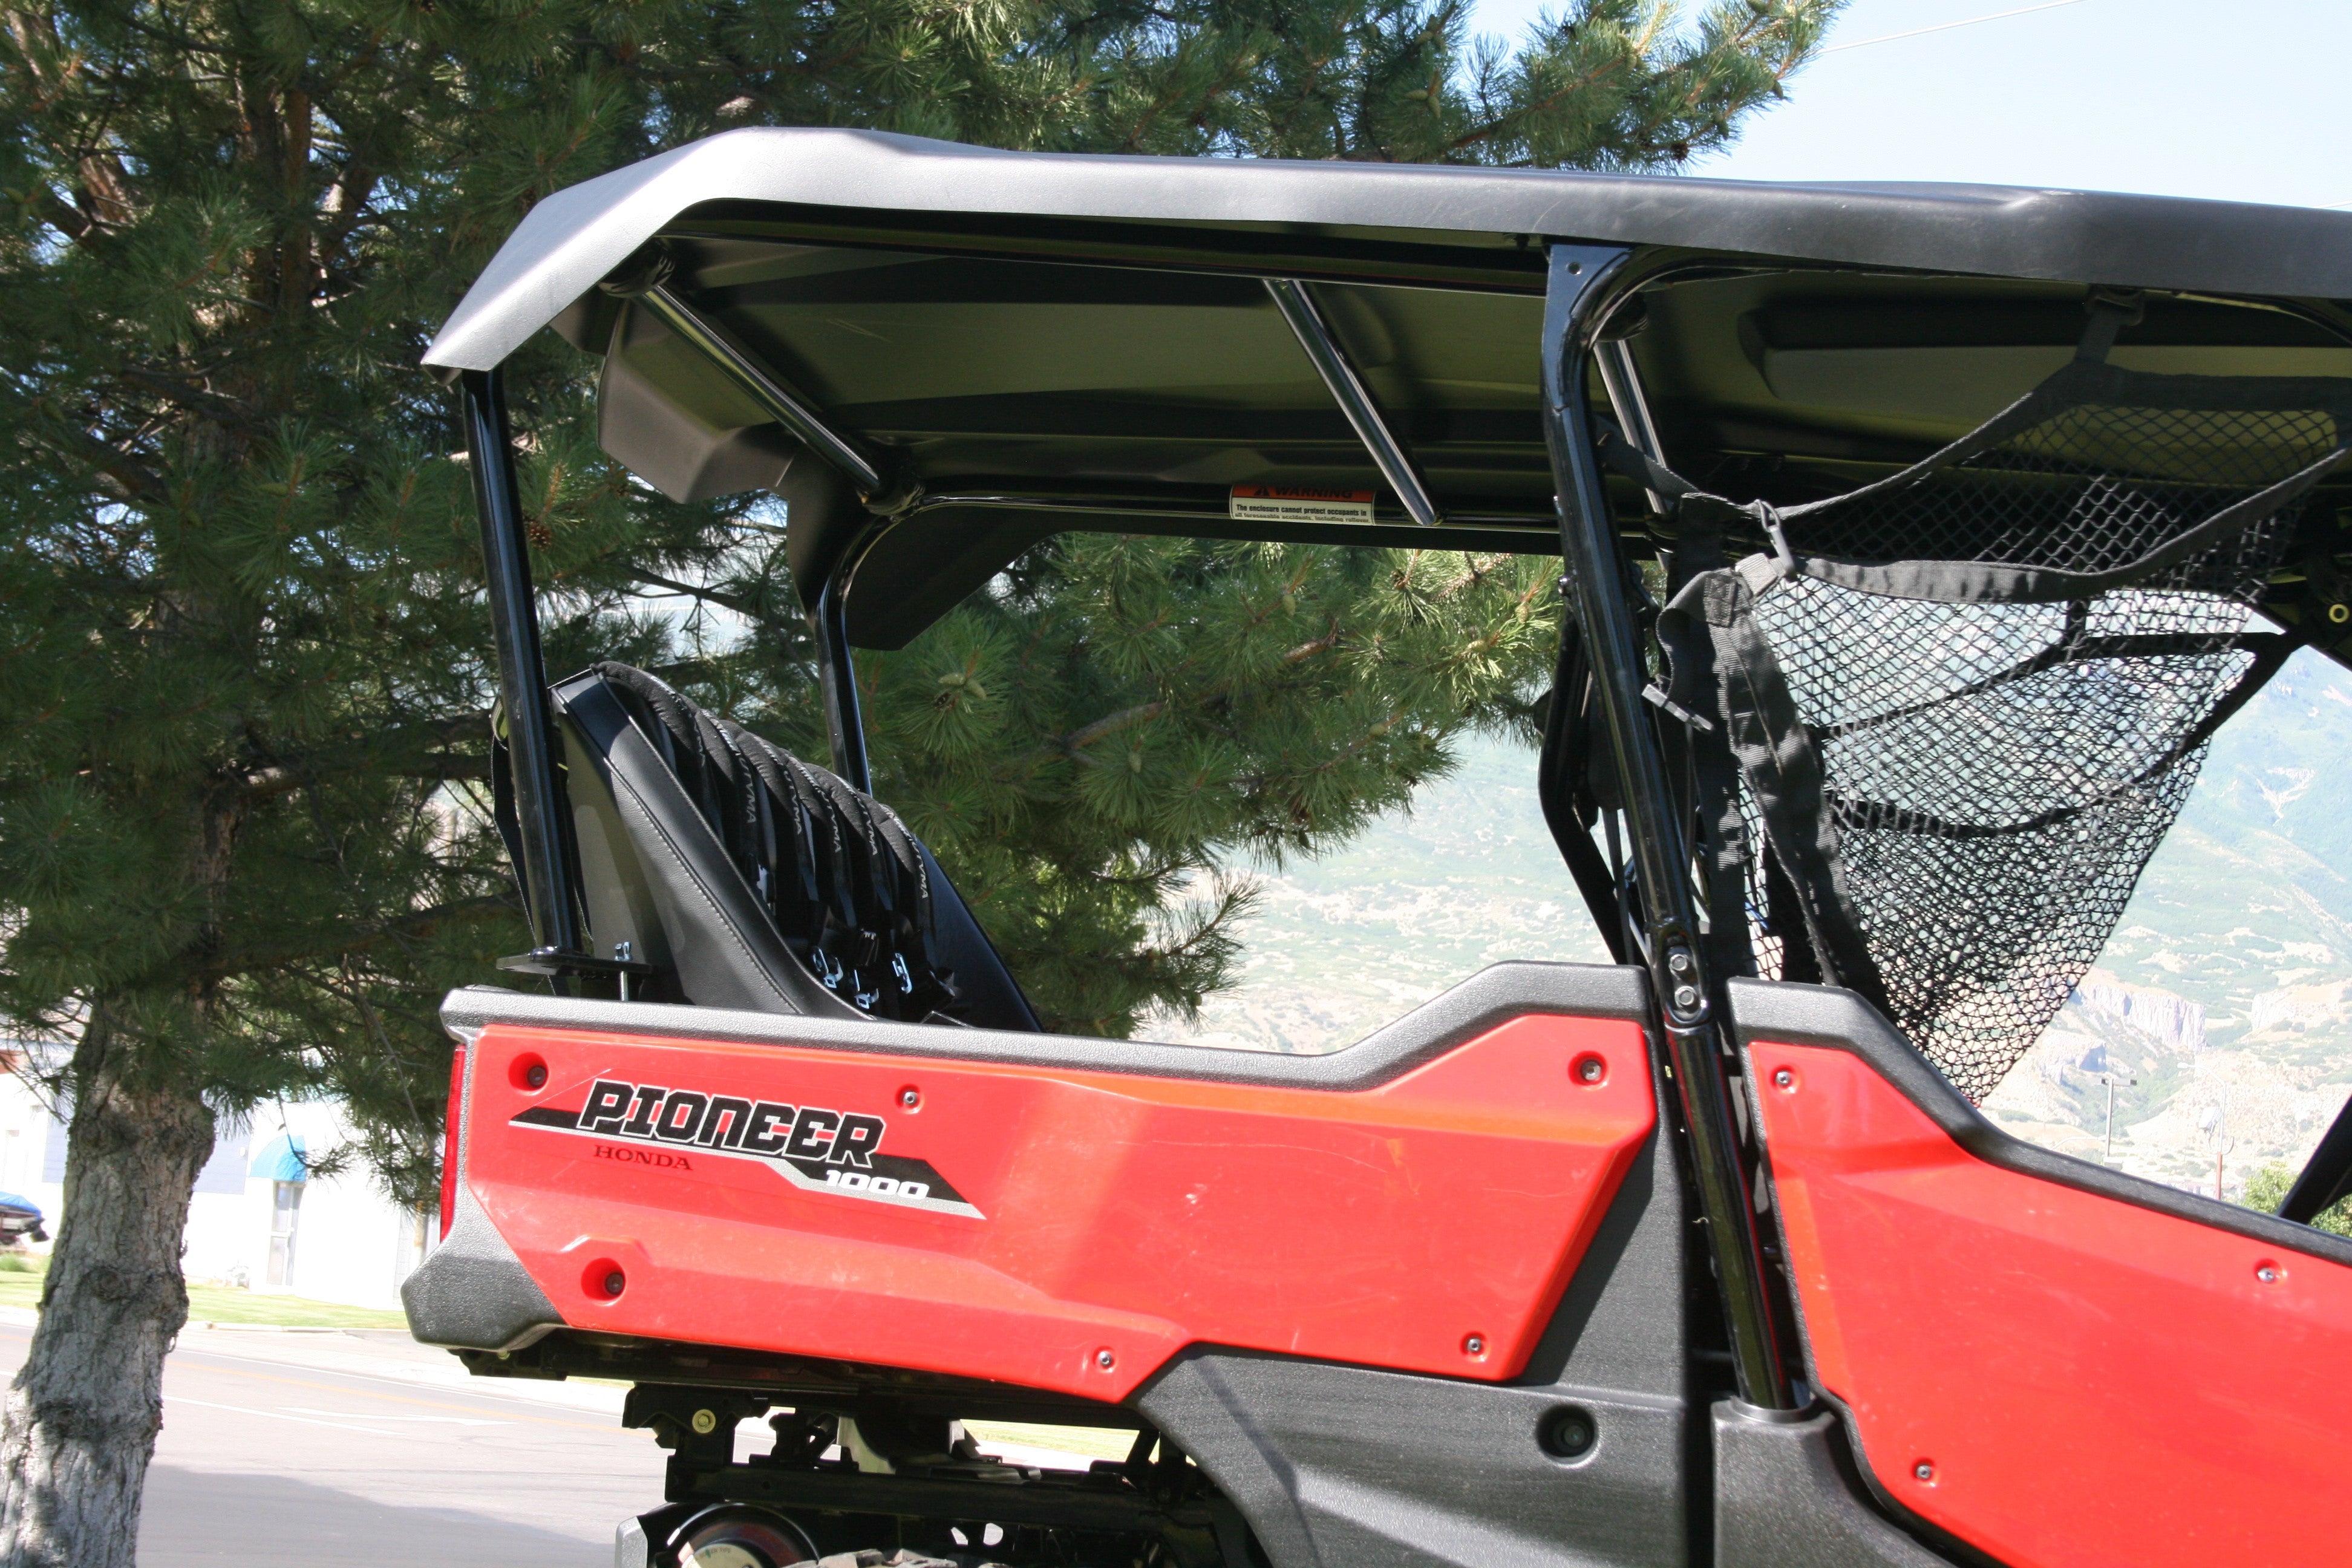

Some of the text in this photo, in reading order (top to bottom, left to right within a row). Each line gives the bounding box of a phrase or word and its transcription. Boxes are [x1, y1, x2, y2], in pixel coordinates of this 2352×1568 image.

[1275, 486, 1353, 498] WARNING
[578, 1079, 886, 1169] PIONEER
[593, 1145, 693, 1171] HONDA
[825, 1170, 929, 1200] 1000
